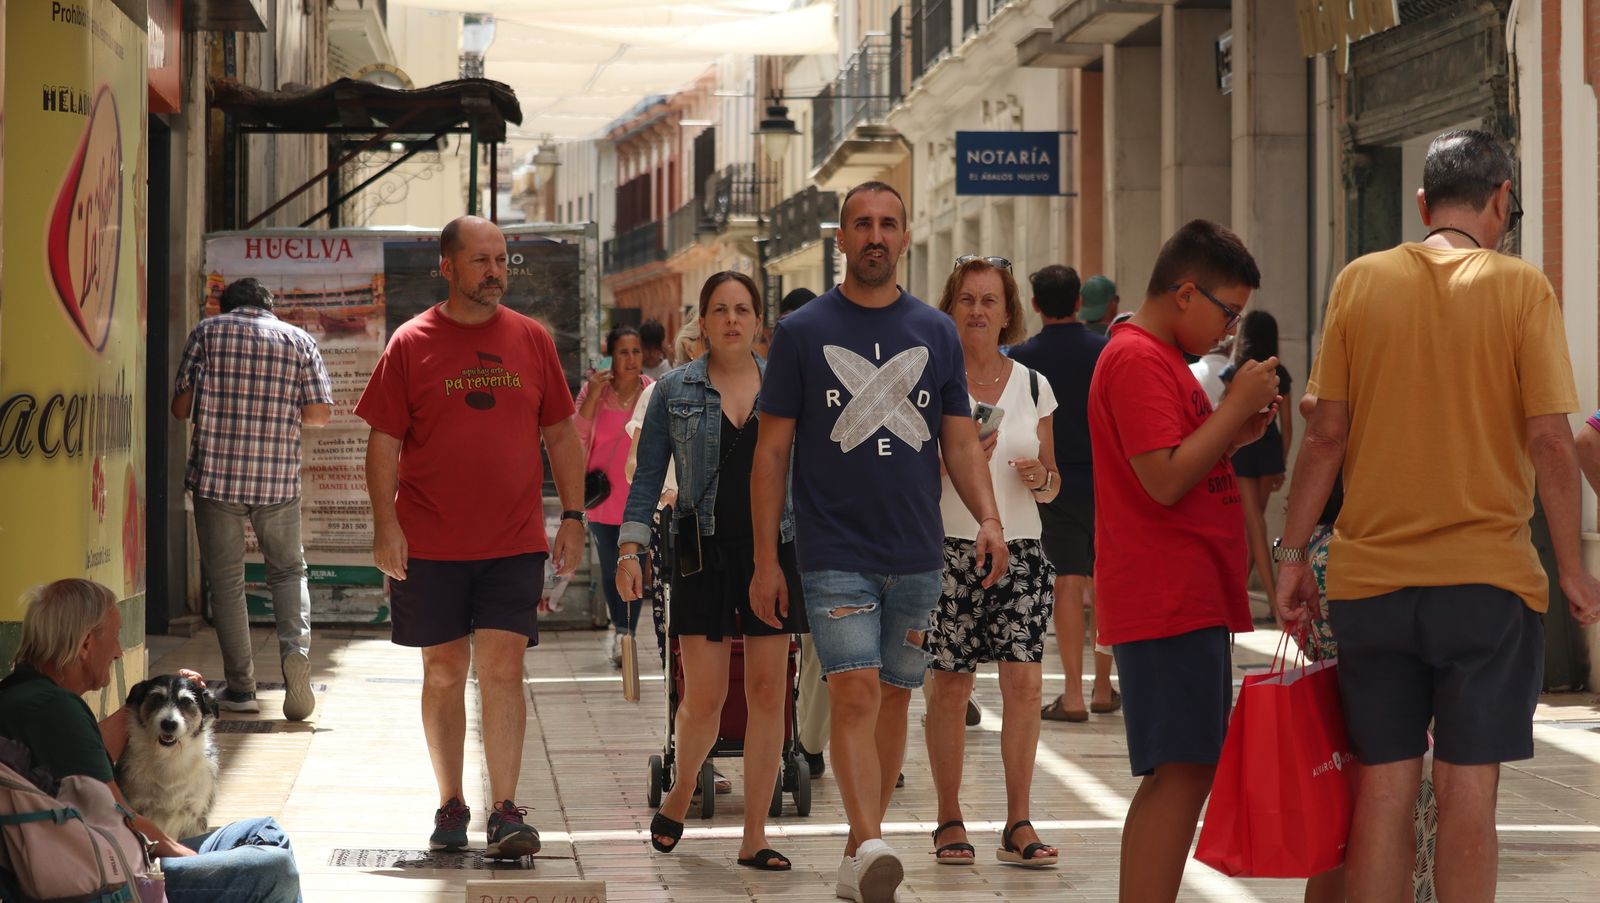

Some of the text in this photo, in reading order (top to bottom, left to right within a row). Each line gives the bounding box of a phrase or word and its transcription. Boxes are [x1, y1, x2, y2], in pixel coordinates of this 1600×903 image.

[966, 146, 1051, 165] NOTARÍA
[1017, 173, 1049, 181] NUEVO
[244, 237, 354, 263] HUELVA
[445, 371, 522, 396] pa reventá
